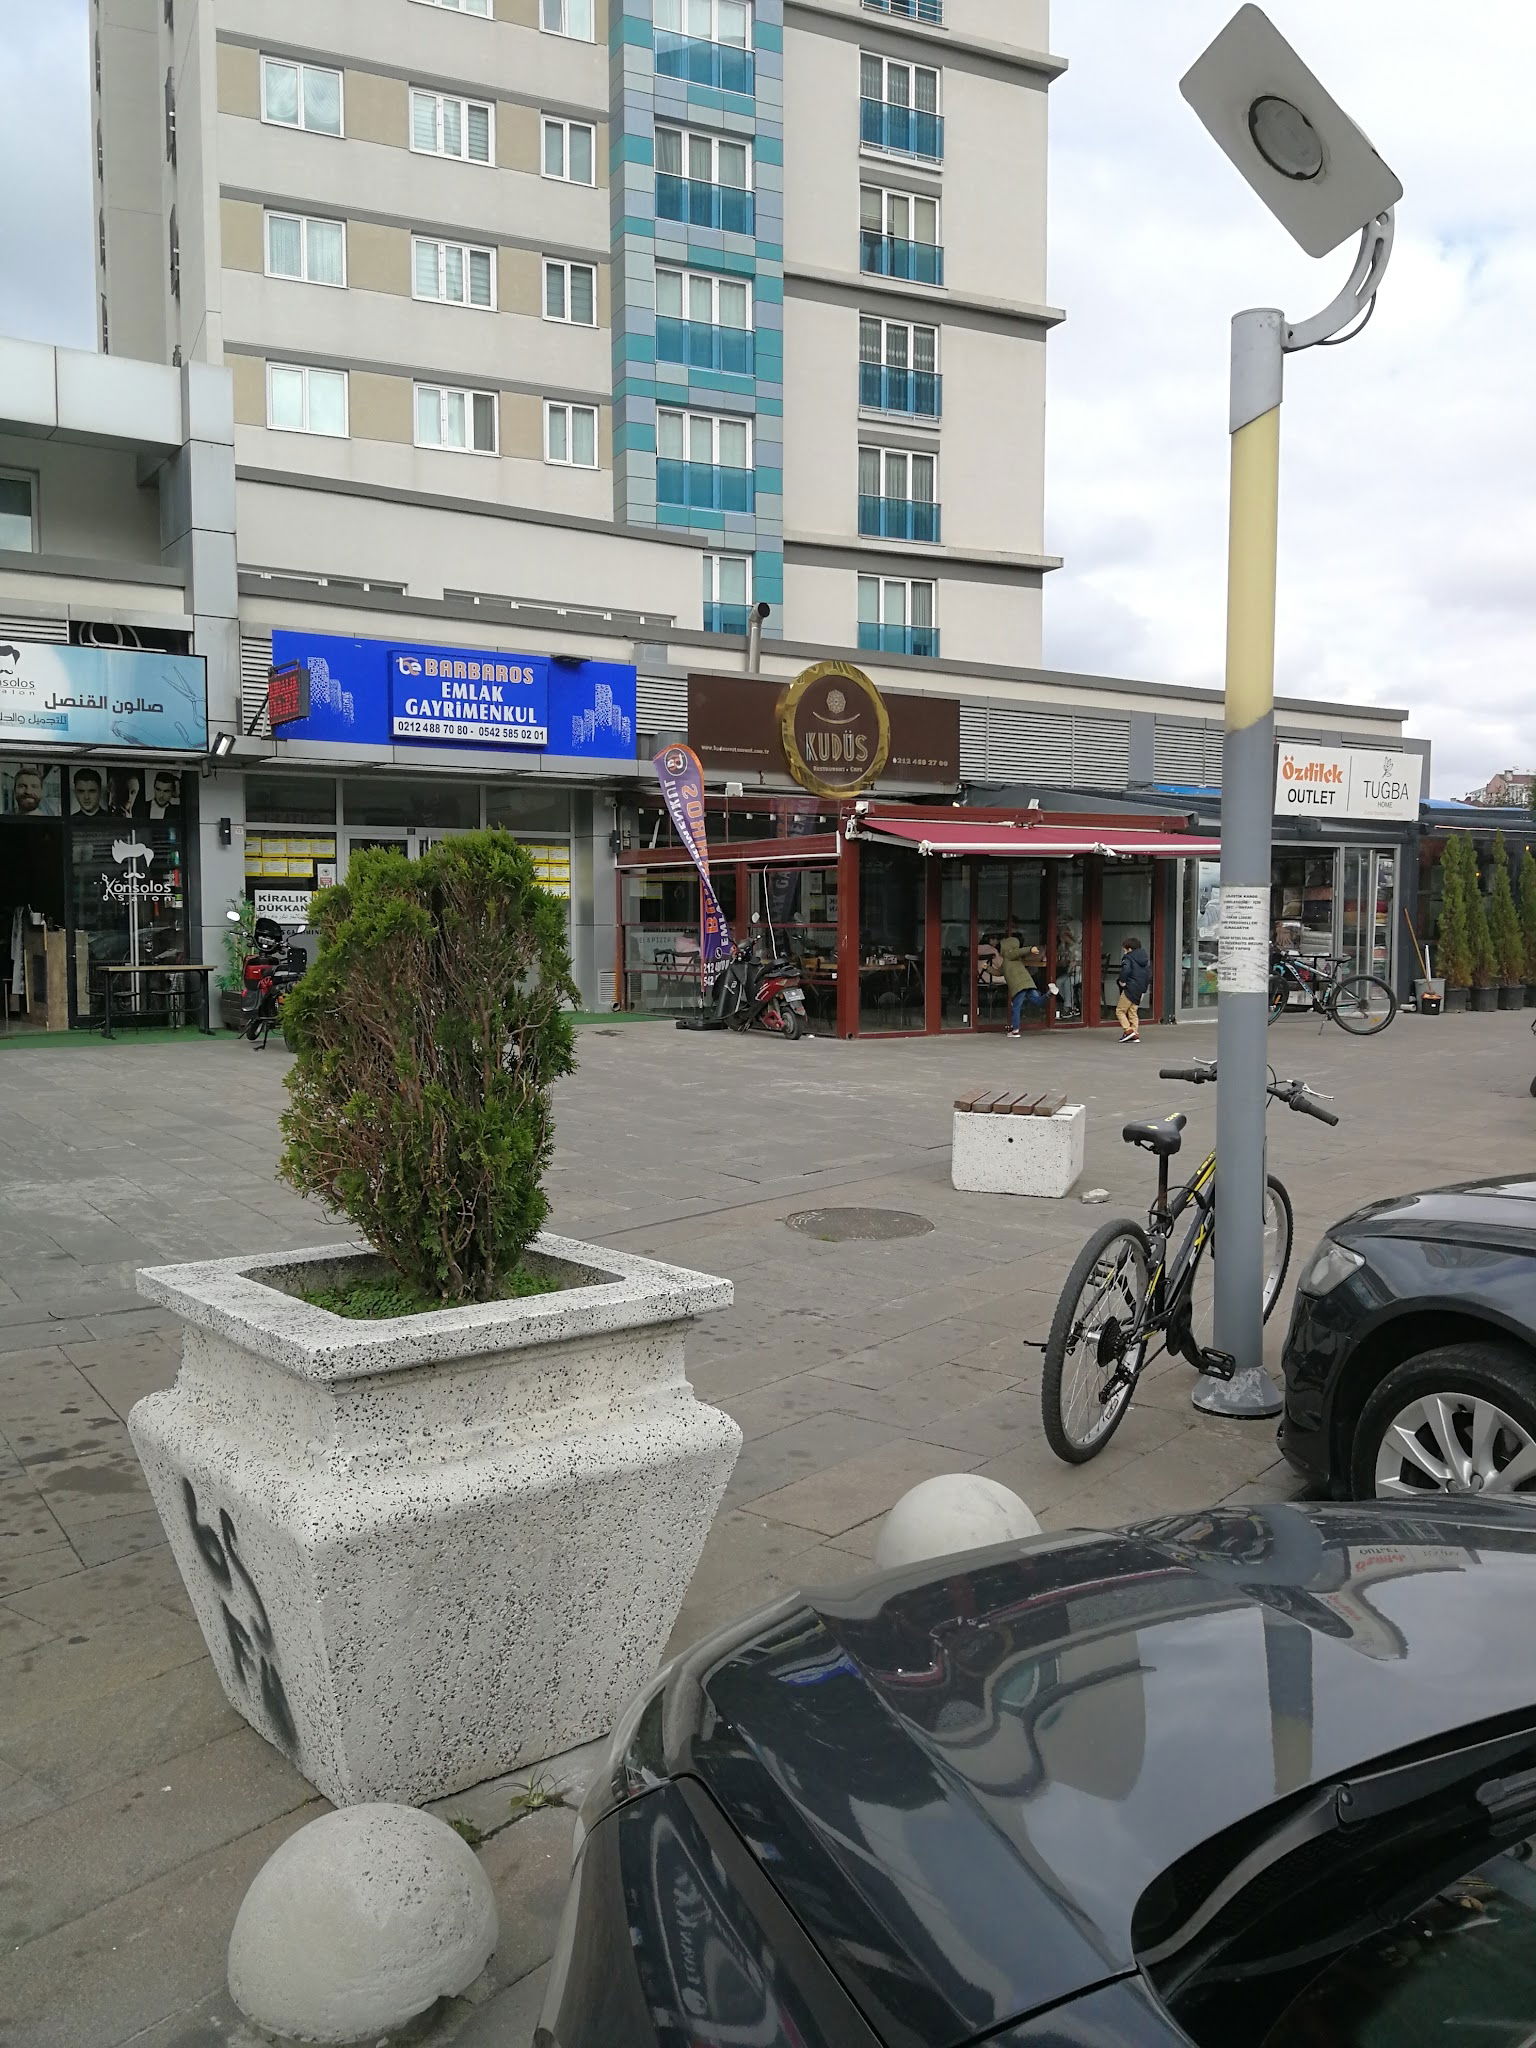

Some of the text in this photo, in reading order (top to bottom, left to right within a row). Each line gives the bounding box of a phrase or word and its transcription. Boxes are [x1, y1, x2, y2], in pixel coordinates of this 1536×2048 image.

[425, 658, 534, 684] BARBAROS
[441, 681, 504, 702] EMLAK
[45, 692, 164, 715] صالون القنصل
[404, 698, 537, 723] GAYRİMENKUL
[398, 721, 421, 733] 0212
[423, 722, 441, 734] 488
[443, 724, 455, 735] 70
[457, 724, 468, 735] 80
[479, 726, 500, 738] 0542
[503, 728, 519, 739] 585
[521, 729, 533, 740] 02
[534, 730, 544, 741] 01
[805, 730, 869, 762] KUDÜS
[1282, 755, 1344, 784] Özdilek
[1287, 788, 1336, 805] OUTLET
[1377, 801, 1393, 809] HOME
[257, 903, 308, 912] DÜKKAN
[258, 893, 308, 903] KİRALIK
